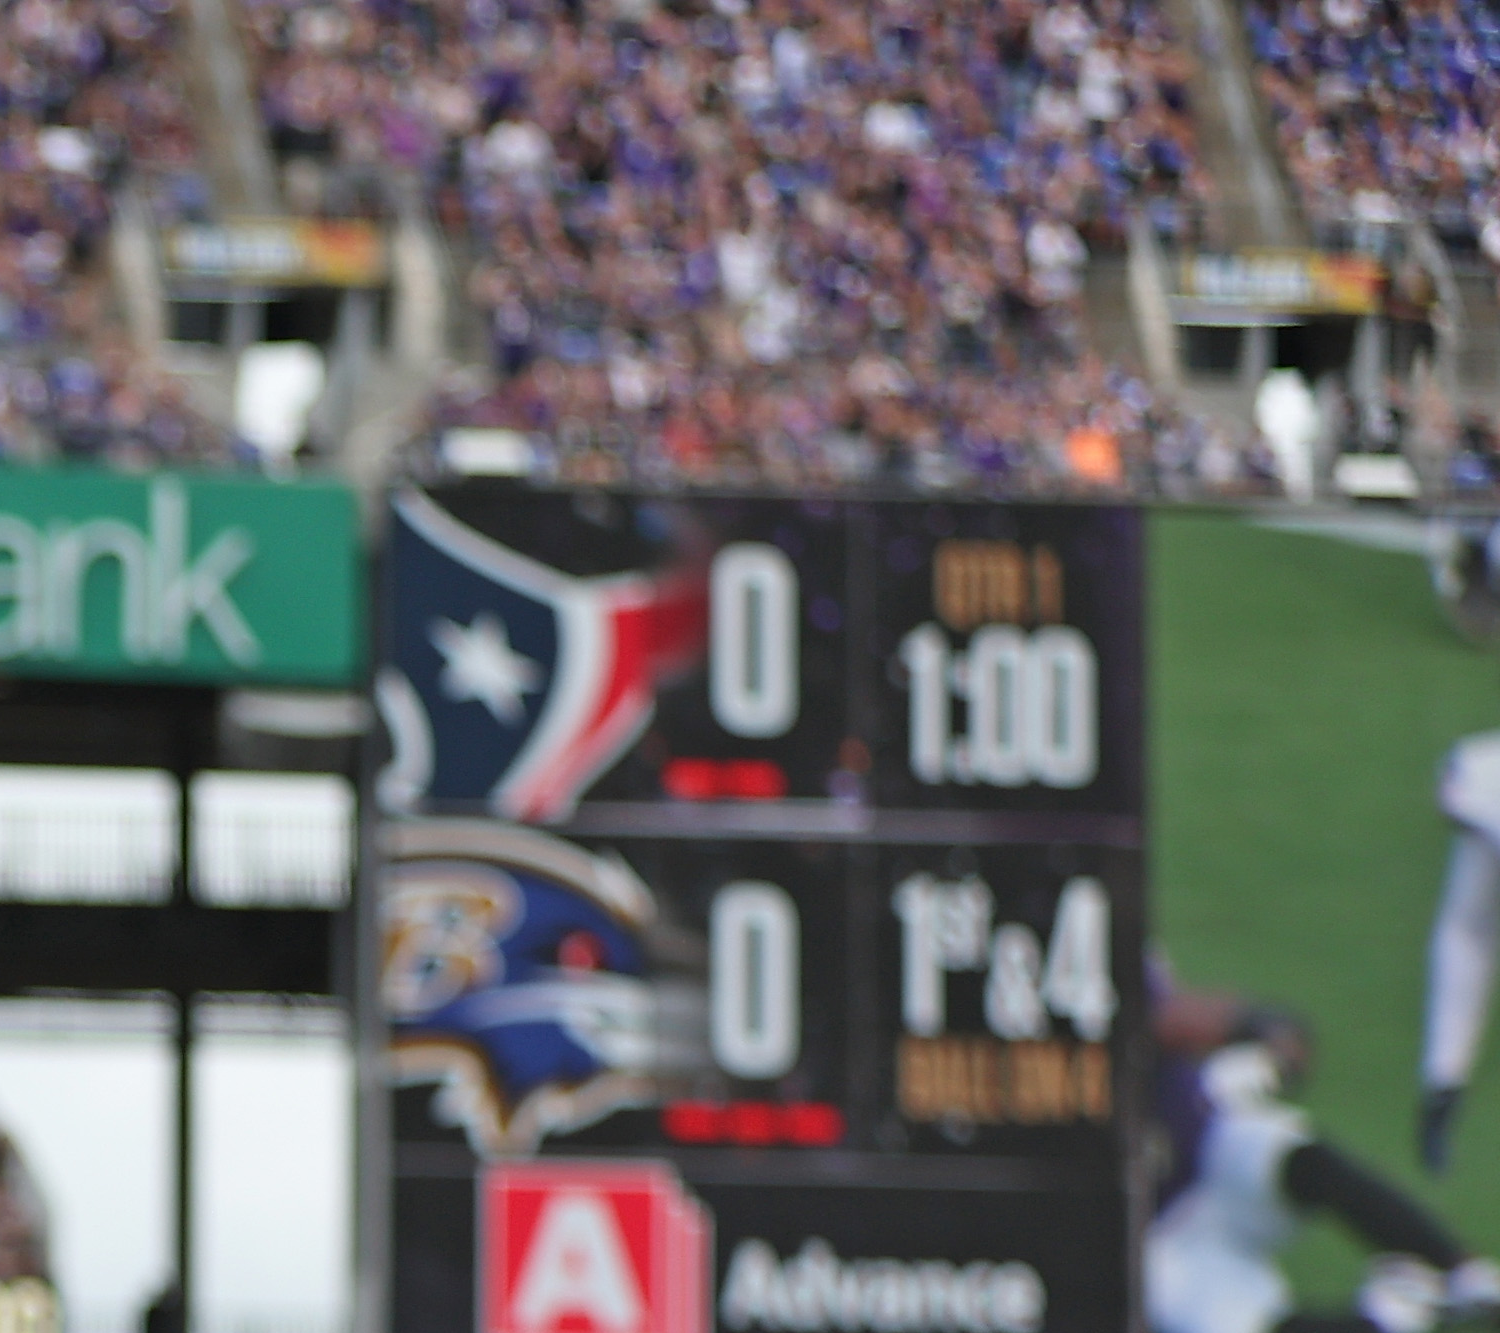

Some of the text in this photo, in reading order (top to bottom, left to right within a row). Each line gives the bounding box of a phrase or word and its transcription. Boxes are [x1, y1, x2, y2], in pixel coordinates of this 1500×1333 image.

[708, 543, 801, 738] 0
[902, 621, 1098, 788] 1:00
[708, 880, 801, 1080] 0
